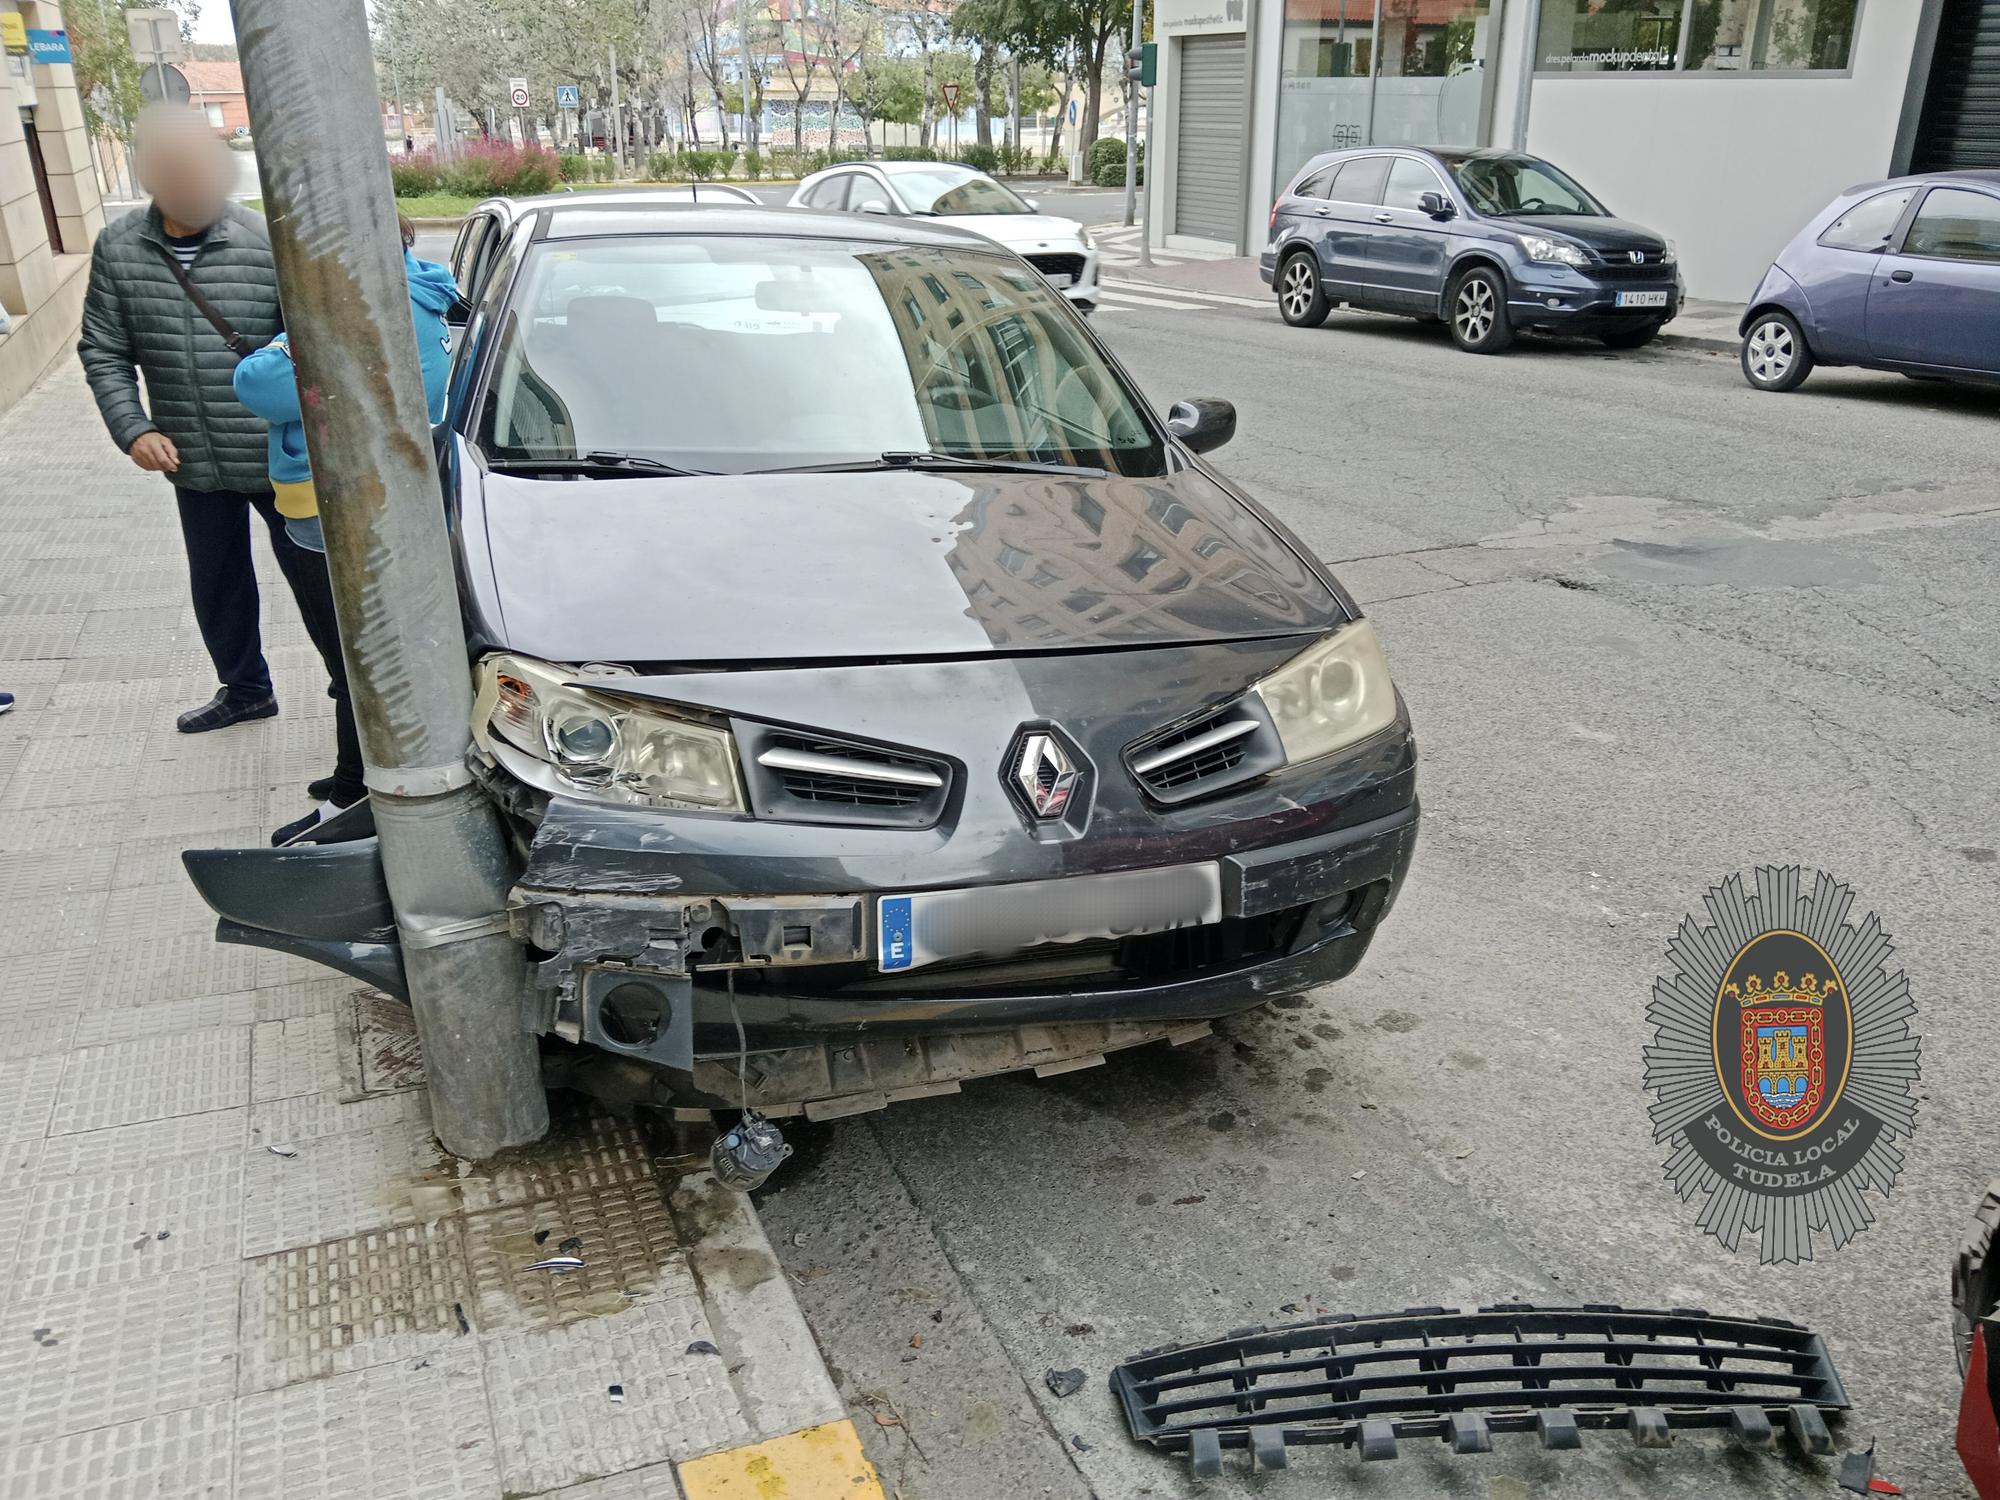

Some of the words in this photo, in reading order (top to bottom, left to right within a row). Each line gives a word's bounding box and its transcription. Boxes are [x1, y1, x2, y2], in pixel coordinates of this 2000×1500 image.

[29, 42, 66, 52] LEBARA
[515, 93, 525, 101] 20
[1624, 293, 1646, 305] 1410
[890, 941, 905, 959] E
